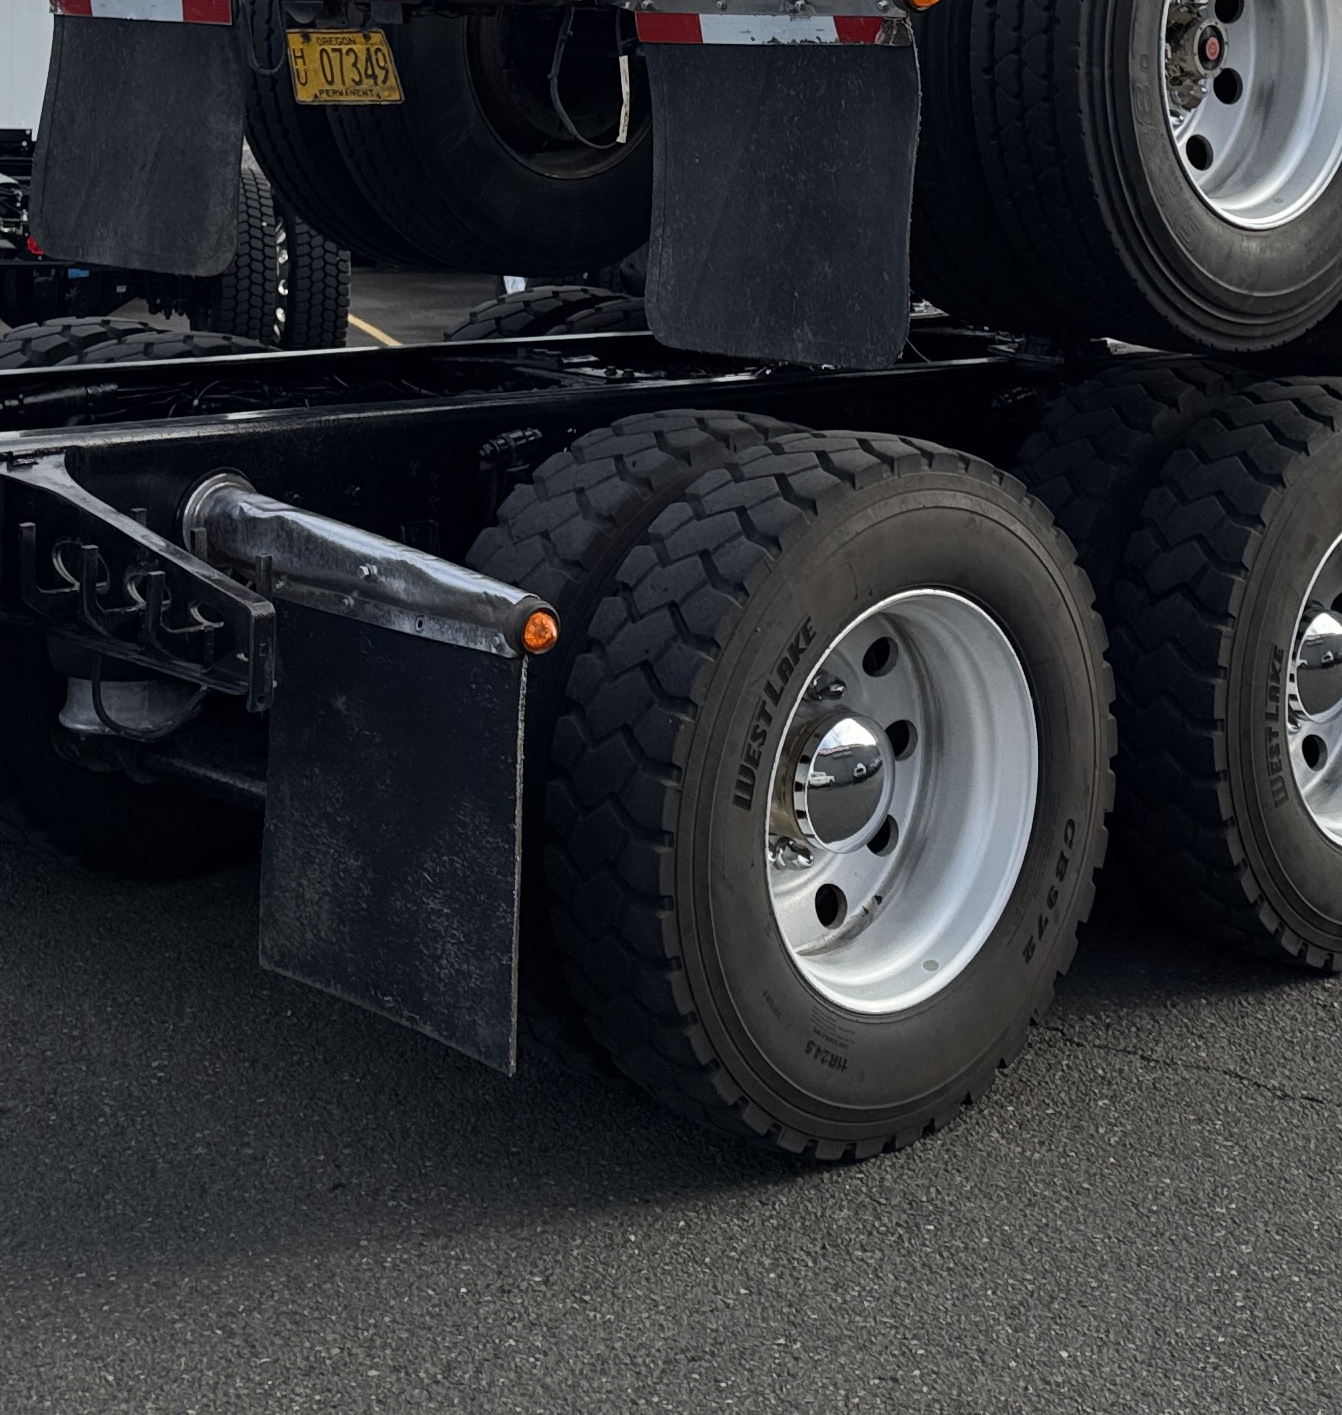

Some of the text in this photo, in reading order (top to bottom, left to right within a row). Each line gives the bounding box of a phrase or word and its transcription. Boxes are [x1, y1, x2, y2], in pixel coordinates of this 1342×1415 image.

[317, 36, 357, 46] OREGON
[319, 47, 390, 86] 07349
[732, 616, 816, 813] WESTLAKE
[1262, 643, 1286, 809] WESTLAKE
[1021, 817, 1077, 965] CB972
